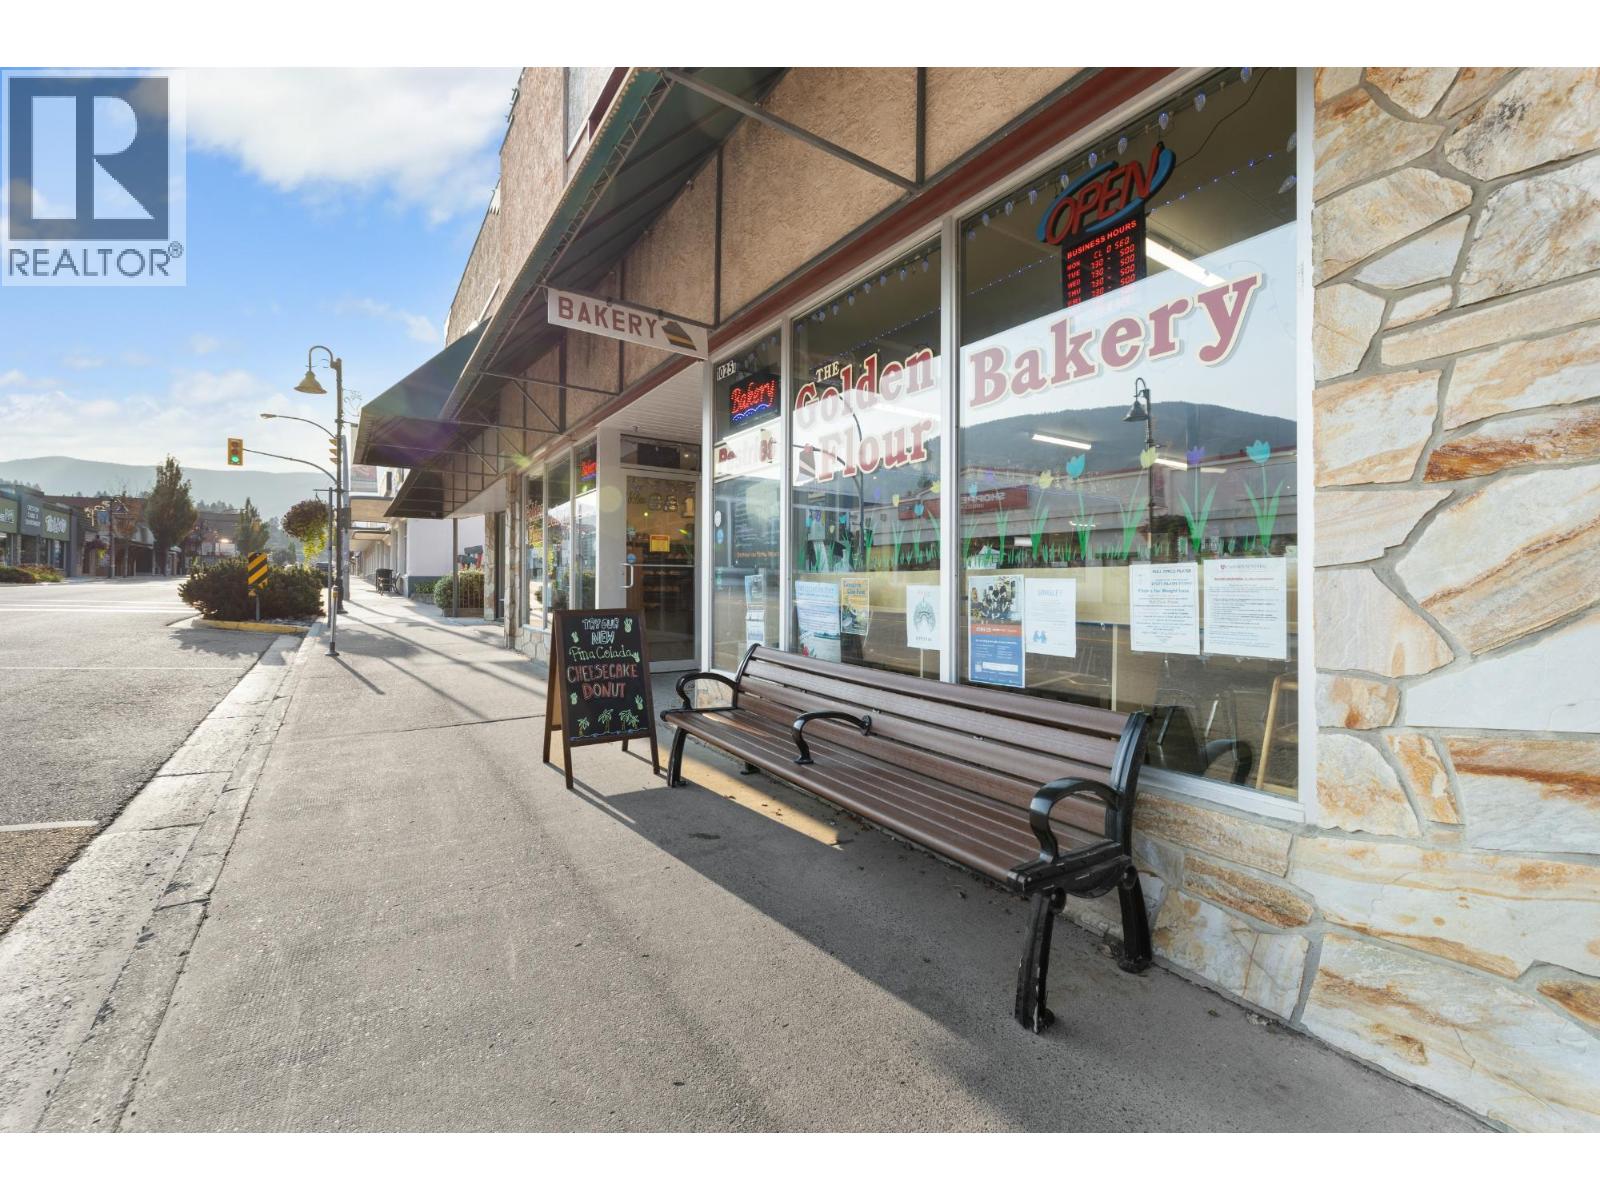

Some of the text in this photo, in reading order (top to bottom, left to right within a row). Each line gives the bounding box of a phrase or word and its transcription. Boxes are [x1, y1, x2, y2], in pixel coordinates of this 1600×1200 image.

[1045, 144, 1161, 245] OPEN
[1067, 220, 1137, 259] BUSINESS HOURS
[1067, 279, 1080, 288] WED
[1091, 268, 1104, 278] 730
[1120, 254, 1135, 266] 500
[1068, 270, 1080, 279] TUE
[1091, 259, 1104, 269] 730
[1120, 244, 1135, 256] 500
[1091, 277, 1104, 287] 730
[1120, 264, 1135, 276] 500
[558, 296, 657, 338] BAKERY
[968, 272, 1262, 407] Bakery
[795, 348, 935, 428] Golden
[815, 361, 840, 383] THE
[731, 380, 777, 413] Bakery
[818, 418, 933, 483] Flour
[582, 618, 600, 630] TRY
[592, 630, 615, 645] NEW
[596, 645, 632, 659] Colada
[567, 662, 638, 682] CHEESECAKE
[582, 681, 626, 700] DONUT
